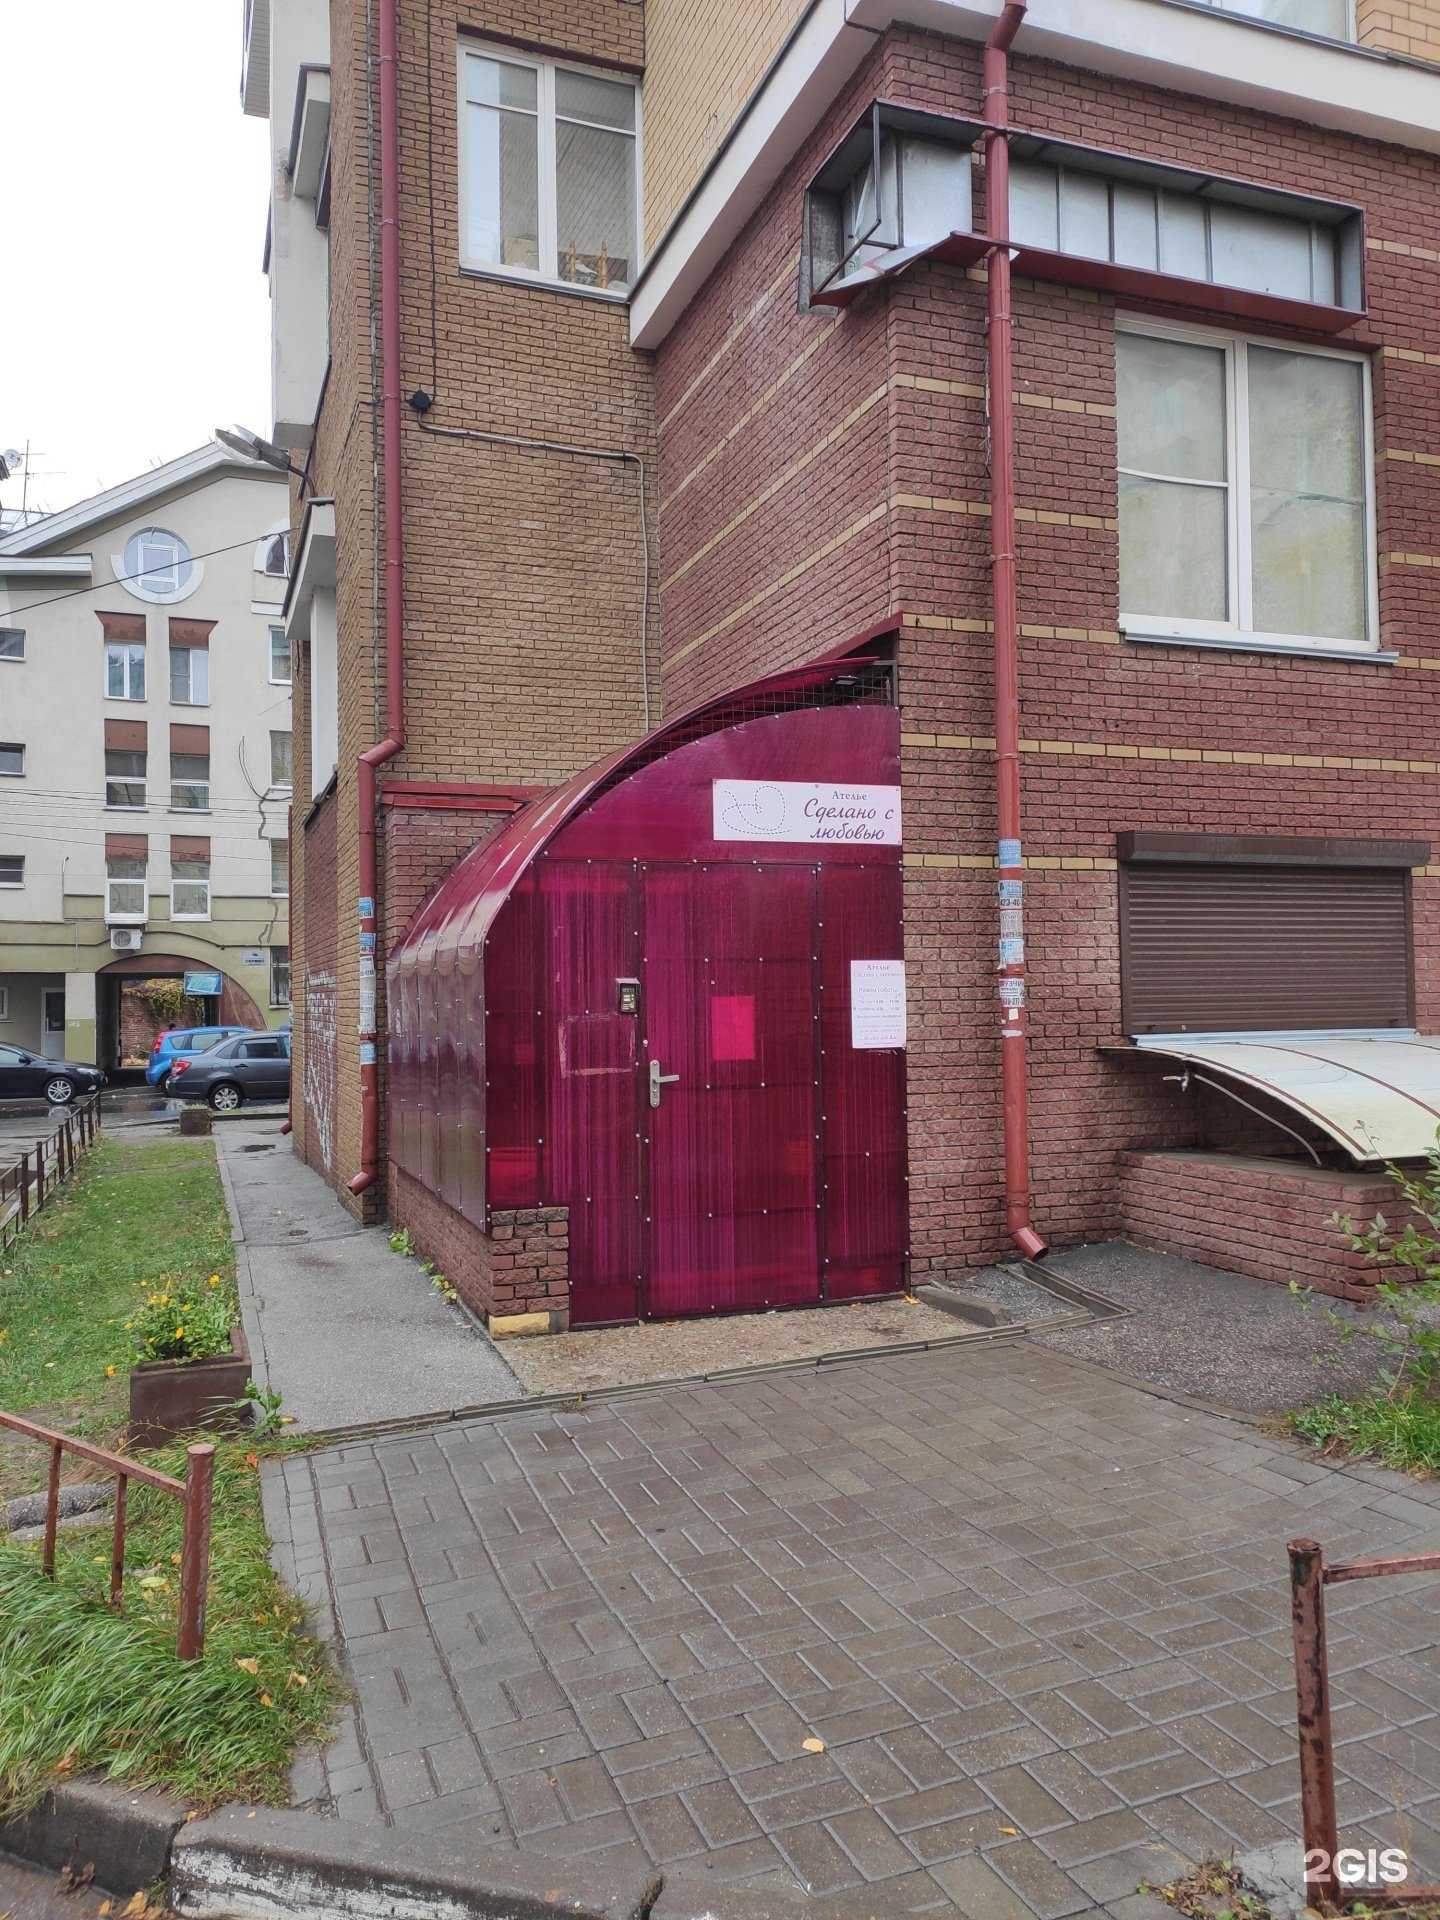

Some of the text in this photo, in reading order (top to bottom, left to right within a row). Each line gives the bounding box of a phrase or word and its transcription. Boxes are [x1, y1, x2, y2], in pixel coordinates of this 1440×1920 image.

[832, 790, 867, 801] Ателье
[804, 798, 895, 823] Сделано с
[810, 823, 885, 840] любовью
